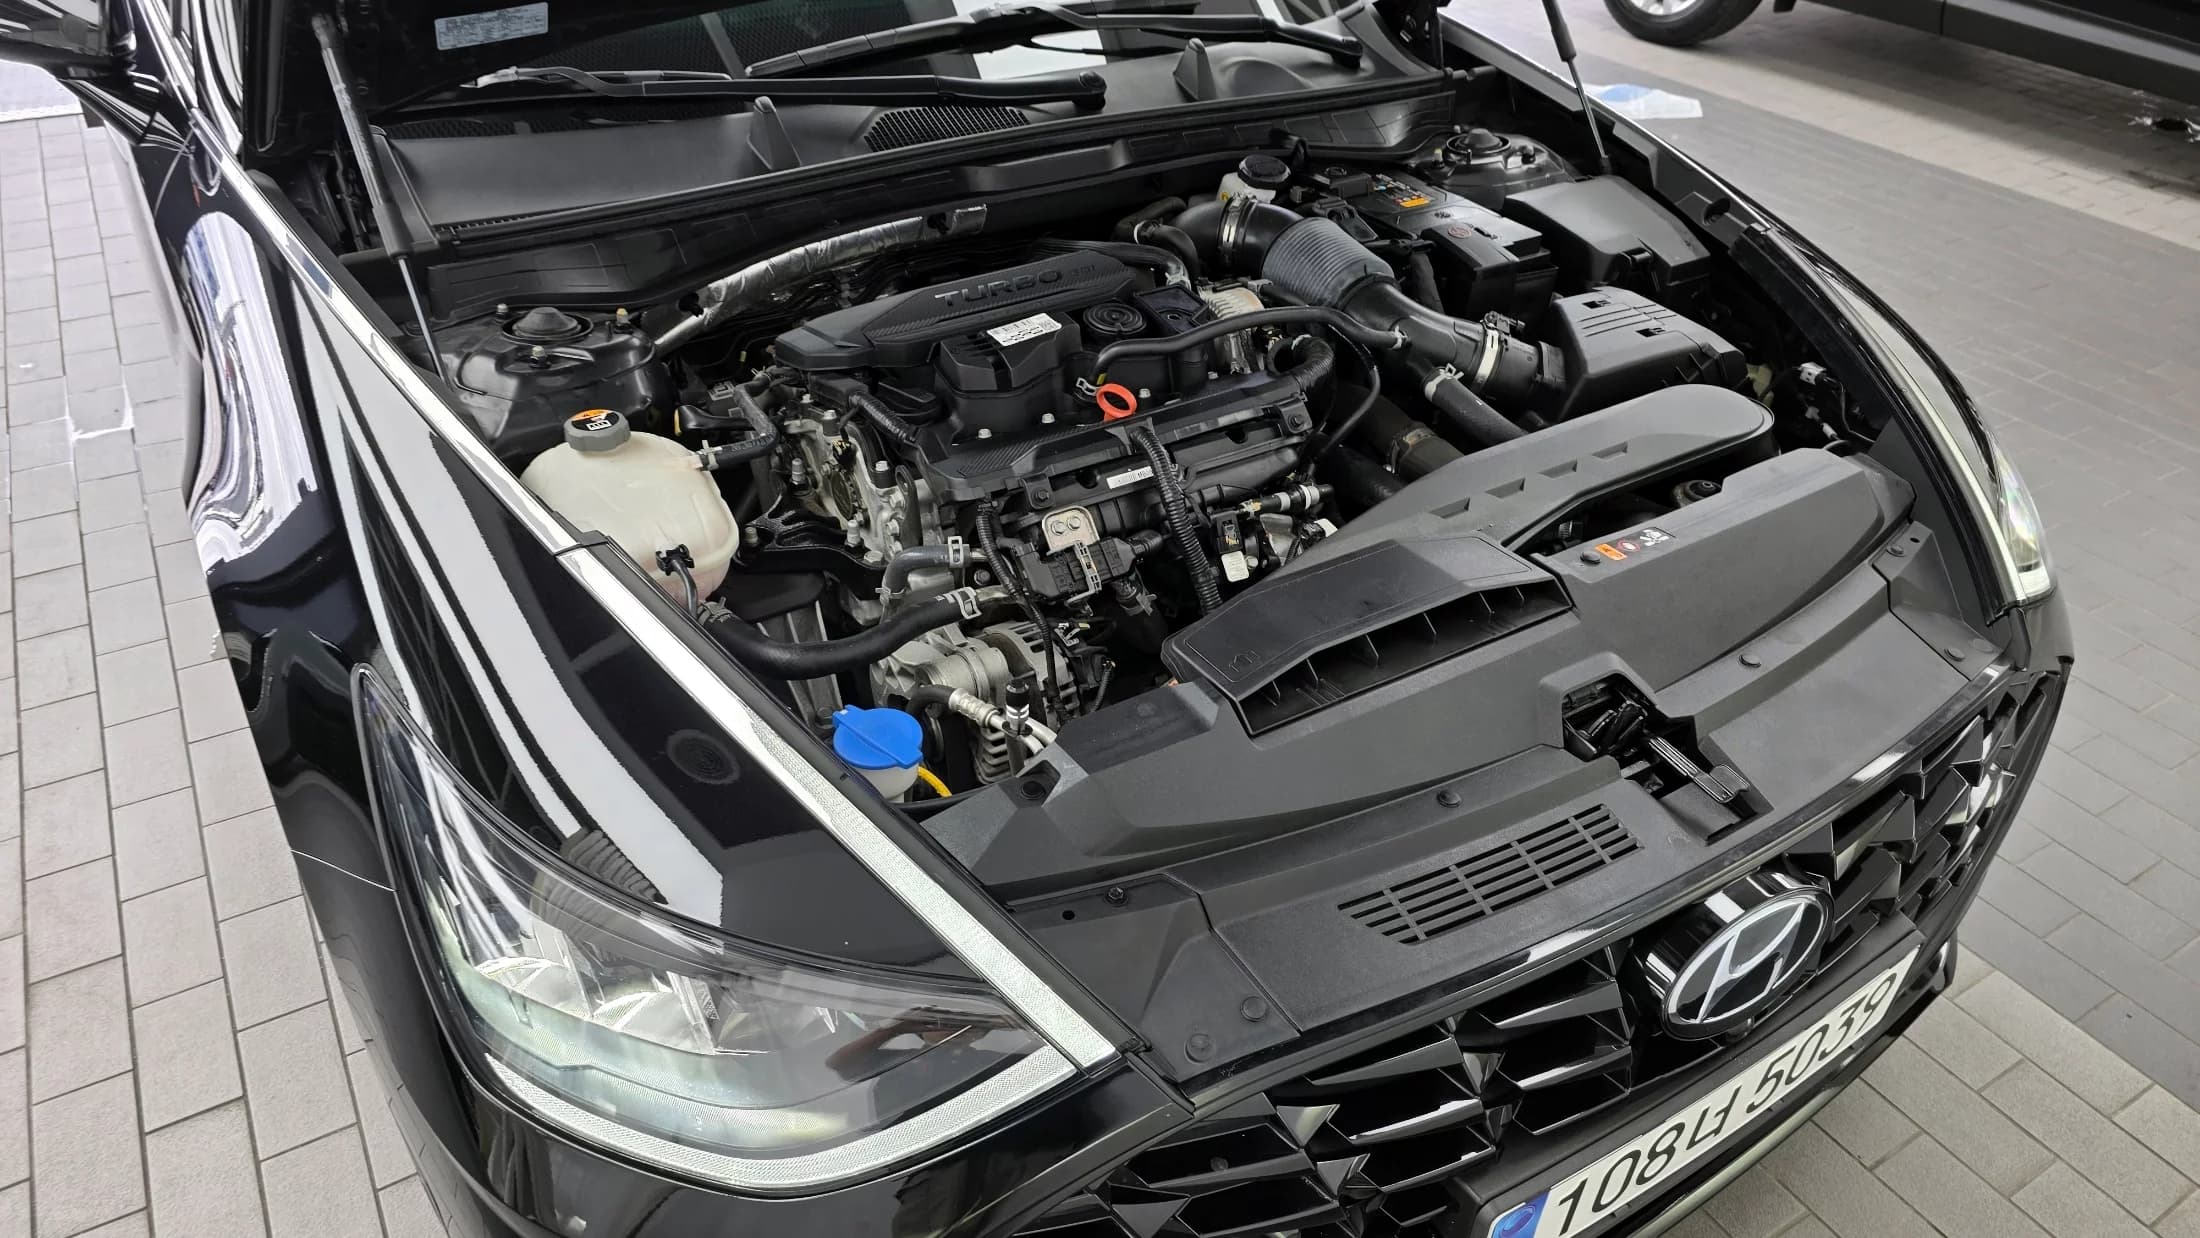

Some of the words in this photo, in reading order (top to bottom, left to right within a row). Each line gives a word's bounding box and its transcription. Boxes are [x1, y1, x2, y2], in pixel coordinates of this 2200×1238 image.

[934, 270, 1061, 306] TURBO
[1558, 1084, 1742, 1237] 108너
[1745, 972, 1898, 1114] 5039
